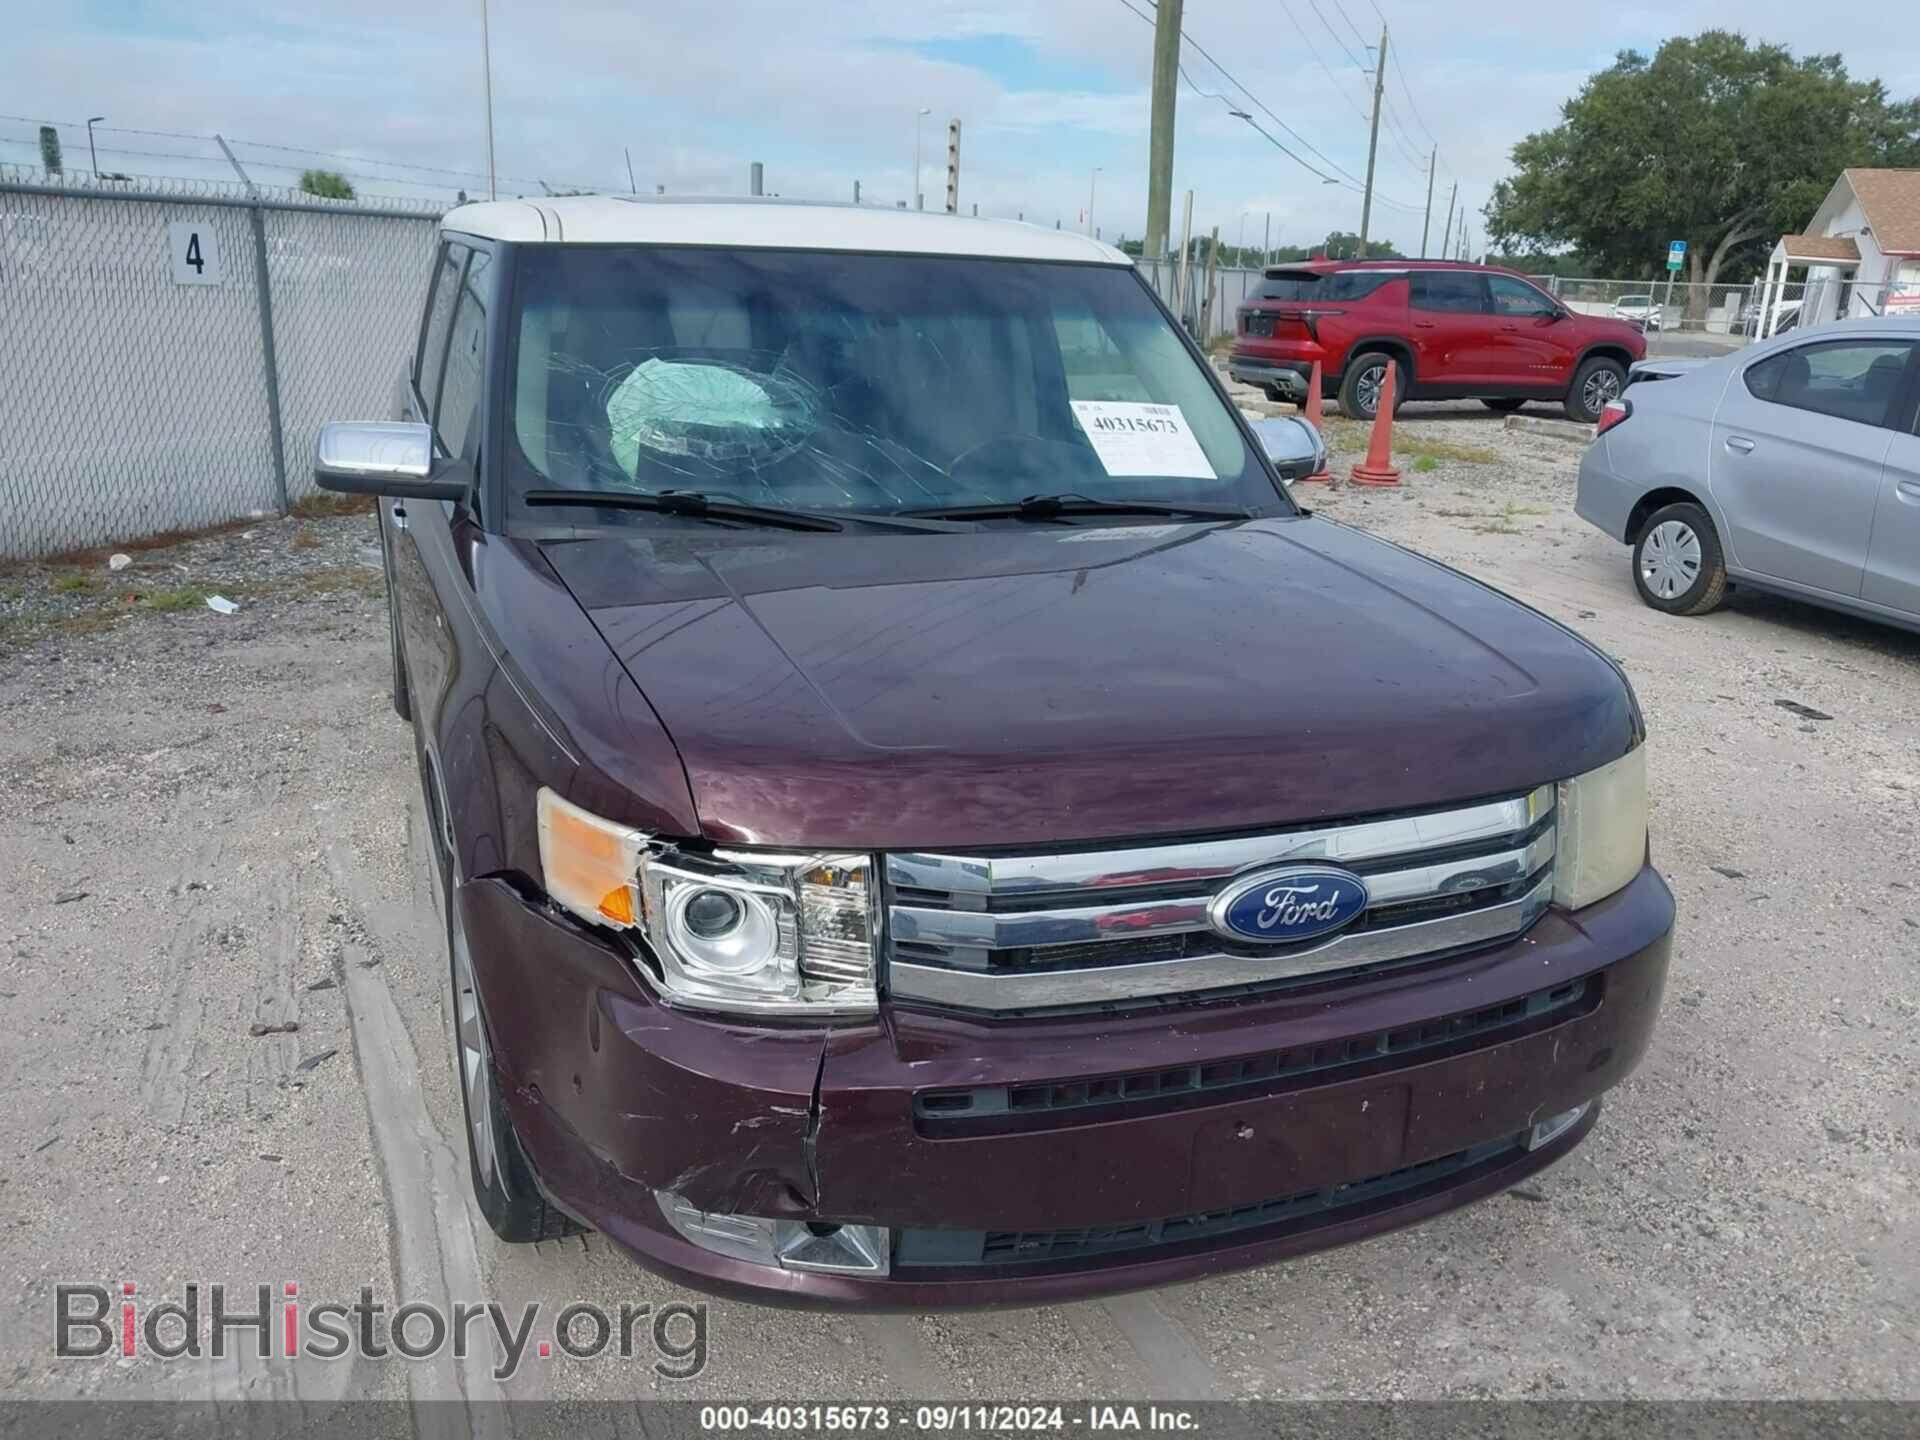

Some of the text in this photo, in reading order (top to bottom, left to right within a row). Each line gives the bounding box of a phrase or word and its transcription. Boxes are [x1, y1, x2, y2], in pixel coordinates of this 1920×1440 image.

[186, 233, 204, 274] 4
[1094, 416, 1178, 434] 40315673
[1257, 884, 1340, 929] Ford
